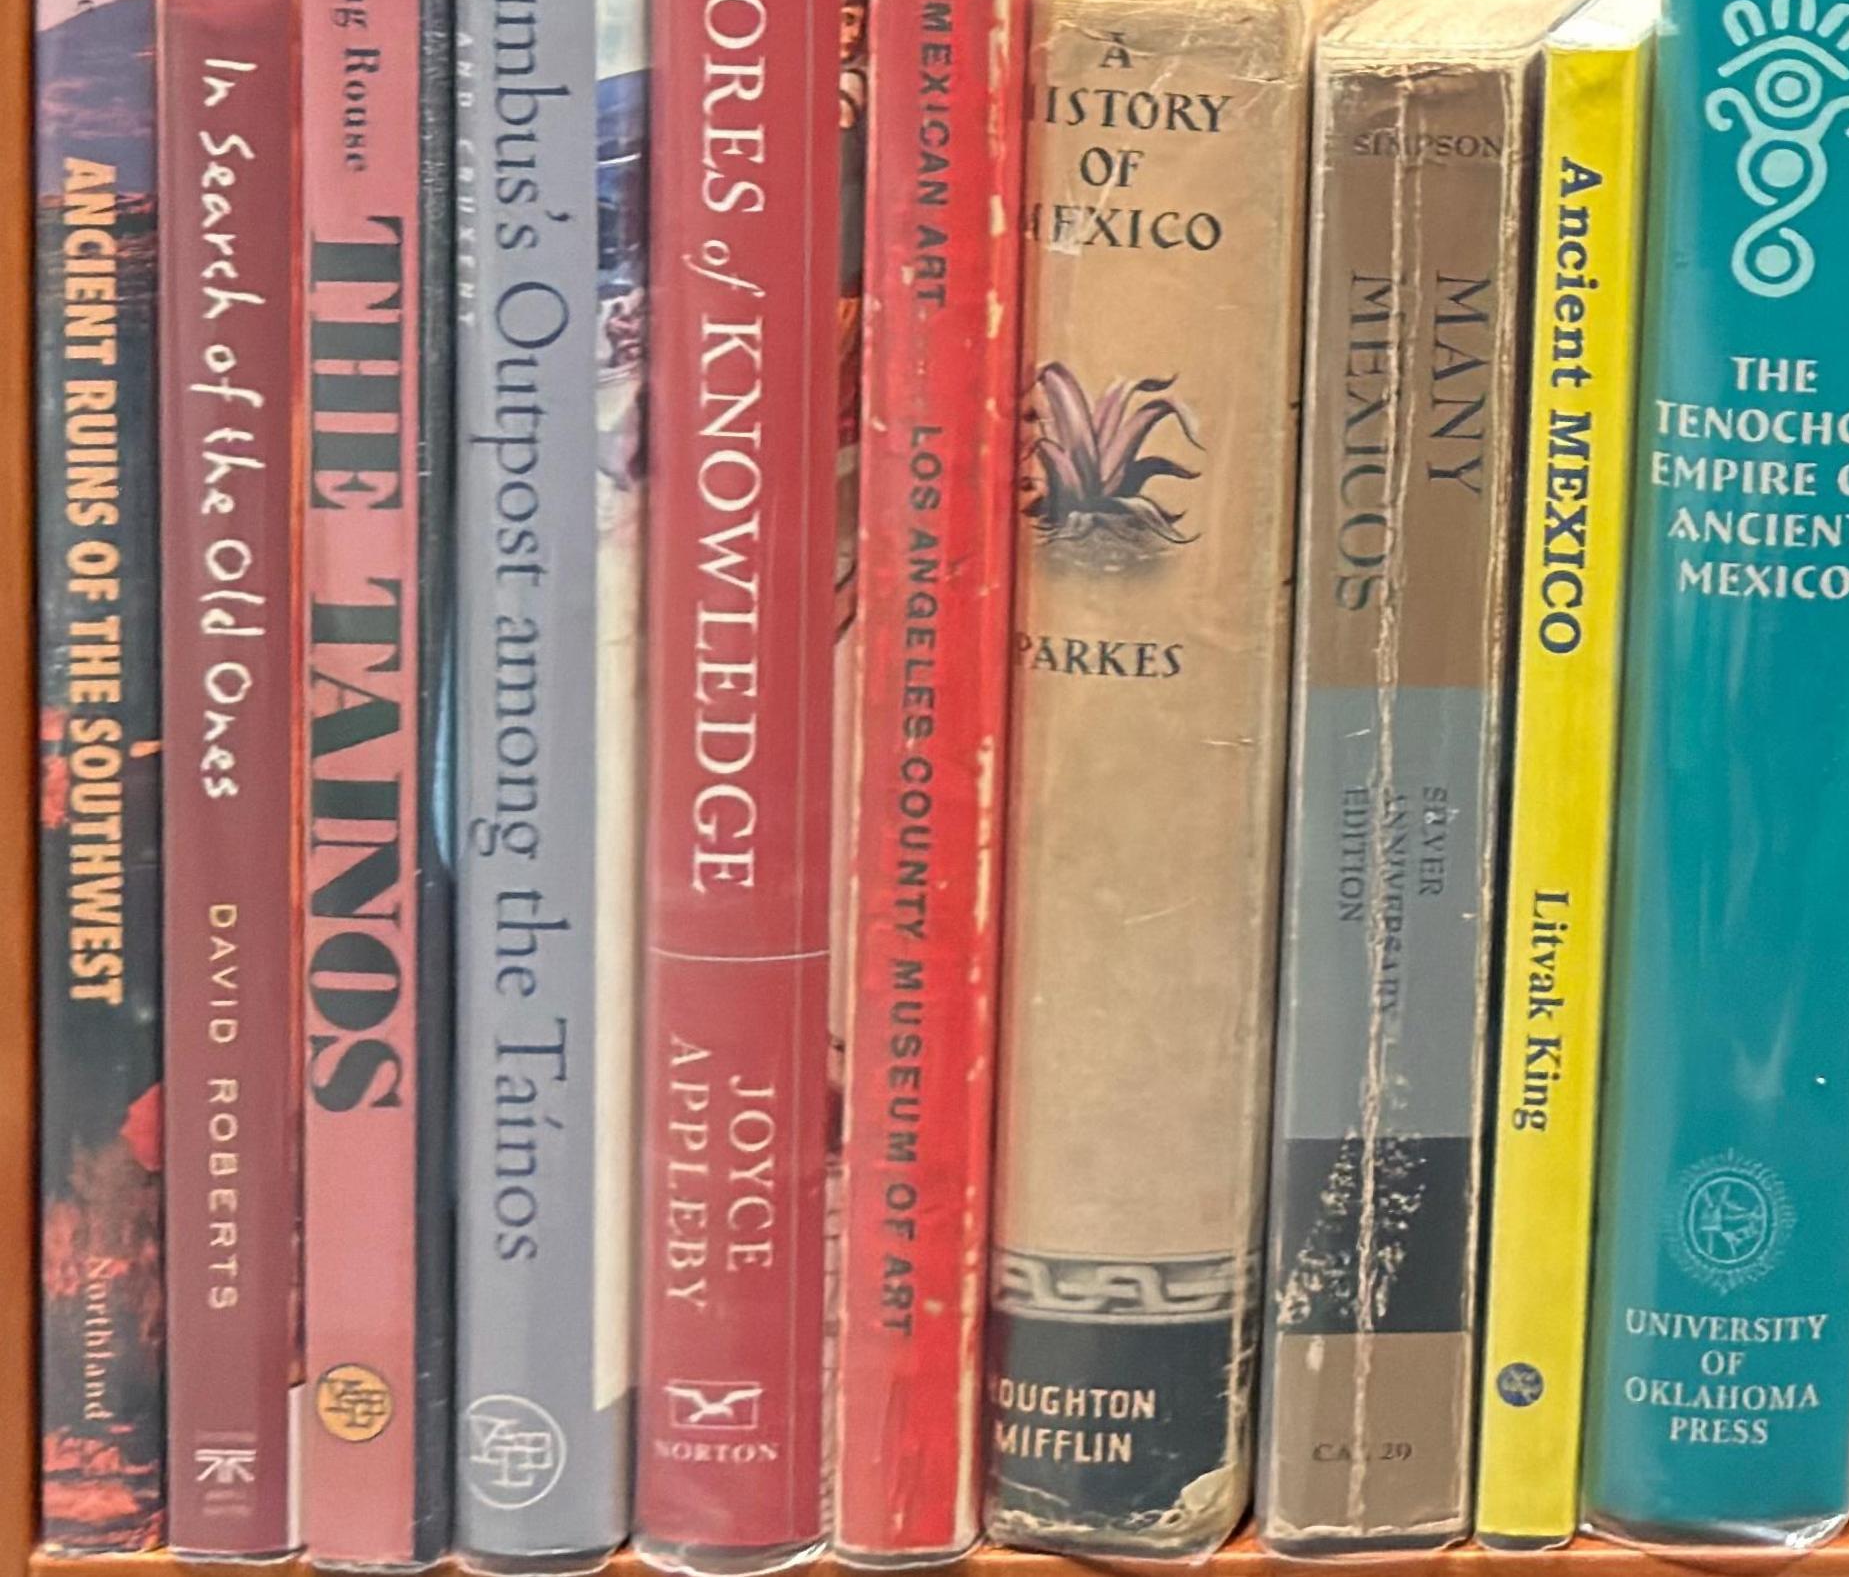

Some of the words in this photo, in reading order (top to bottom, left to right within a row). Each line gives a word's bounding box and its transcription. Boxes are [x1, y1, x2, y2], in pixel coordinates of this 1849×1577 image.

[203, 59, 258, 107] In
[457, 30, 474, 110] AND
[913, 1, 954, 208] MEXICAN
[1100, 32, 1132, 68] A
[344, 47, 379, 172] Rouse
[1022, 85, 1233, 133] ISTORY
[1352, 133, 1501, 158] SIMPSON
[1081, 147, 1145, 188] OF
[63, 158, 118, 366] ANCIENT
[200, 131, 266, 320] Search
[457, 136, 477, 323] CRUXENT
[682, 238, 762, 298] of
[910, 223, 948, 309] ART
[1550, 156, 1602, 389] Ancient
[190, 344, 264, 409] of
[309, 215, 403, 512] THE
[1428, 270, 1491, 495] MANY
[1730, 355, 1818, 392] THE
[64, 381, 119, 528] RUINS
[199, 428, 264, 516] the
[468, 279, 570, 586] Outpost
[908, 424, 942, 511] LOS
[1335, 272, 1407, 614] MEXICOS
[1650, 455, 1818, 497] EMPIRE
[66, 539, 120, 598] OF
[1539, 410, 1593, 654] MEXICO
[200, 539, 264, 637] Old
[692, 313, 764, 897] KNOWLEDGE
[901, 527, 941, 744] ANGELES
[69, 616, 122, 703] THE
[1014, 631, 1184, 678] PARKES
[198, 659, 251, 802] Ones
[470, 615, 541, 859] among
[69, 720, 123, 1005] SOUTHWEST
[308, 578, 403, 1114] TAINOS
[892, 757, 934, 942] COUNTY
[1338, 788, 1368, 922] EDITION
[1418, 786, 1448, 898] SILVER
[208, 904, 237, 1044] DAVID
[493, 889, 569, 997] the
[1527, 890, 1571, 1020] Litvak
[884, 961, 923, 1165] MUSEUM
[1511, 1035, 1564, 1133] King
[206, 1077, 237, 1311] ROBERTS
[494, 1016, 567, 1263] Taínos
[666, 1035, 711, 1311] APPLEBY
[727, 1075, 775, 1274] JOYCE
[884, 1178, 916, 1242] OF
[82, 1255, 113, 1420] Northland
[880, 1253, 913, 1338] ART
[1625, 1308, 1830, 1343] UNIVERSITY
[987, 1378, 1156, 1420] OUGHTON
[1625, 1376, 1820, 1410] OKLAHOMA
[1701, 1350, 1746, 1376] OF
[653, 1440, 778, 1462] NORTON
[996, 1420, 1132, 1463] MIFFLIN
[1312, 1443, 1371, 1461] CA
[1669, 1417, 1768, 1445] PRESS
